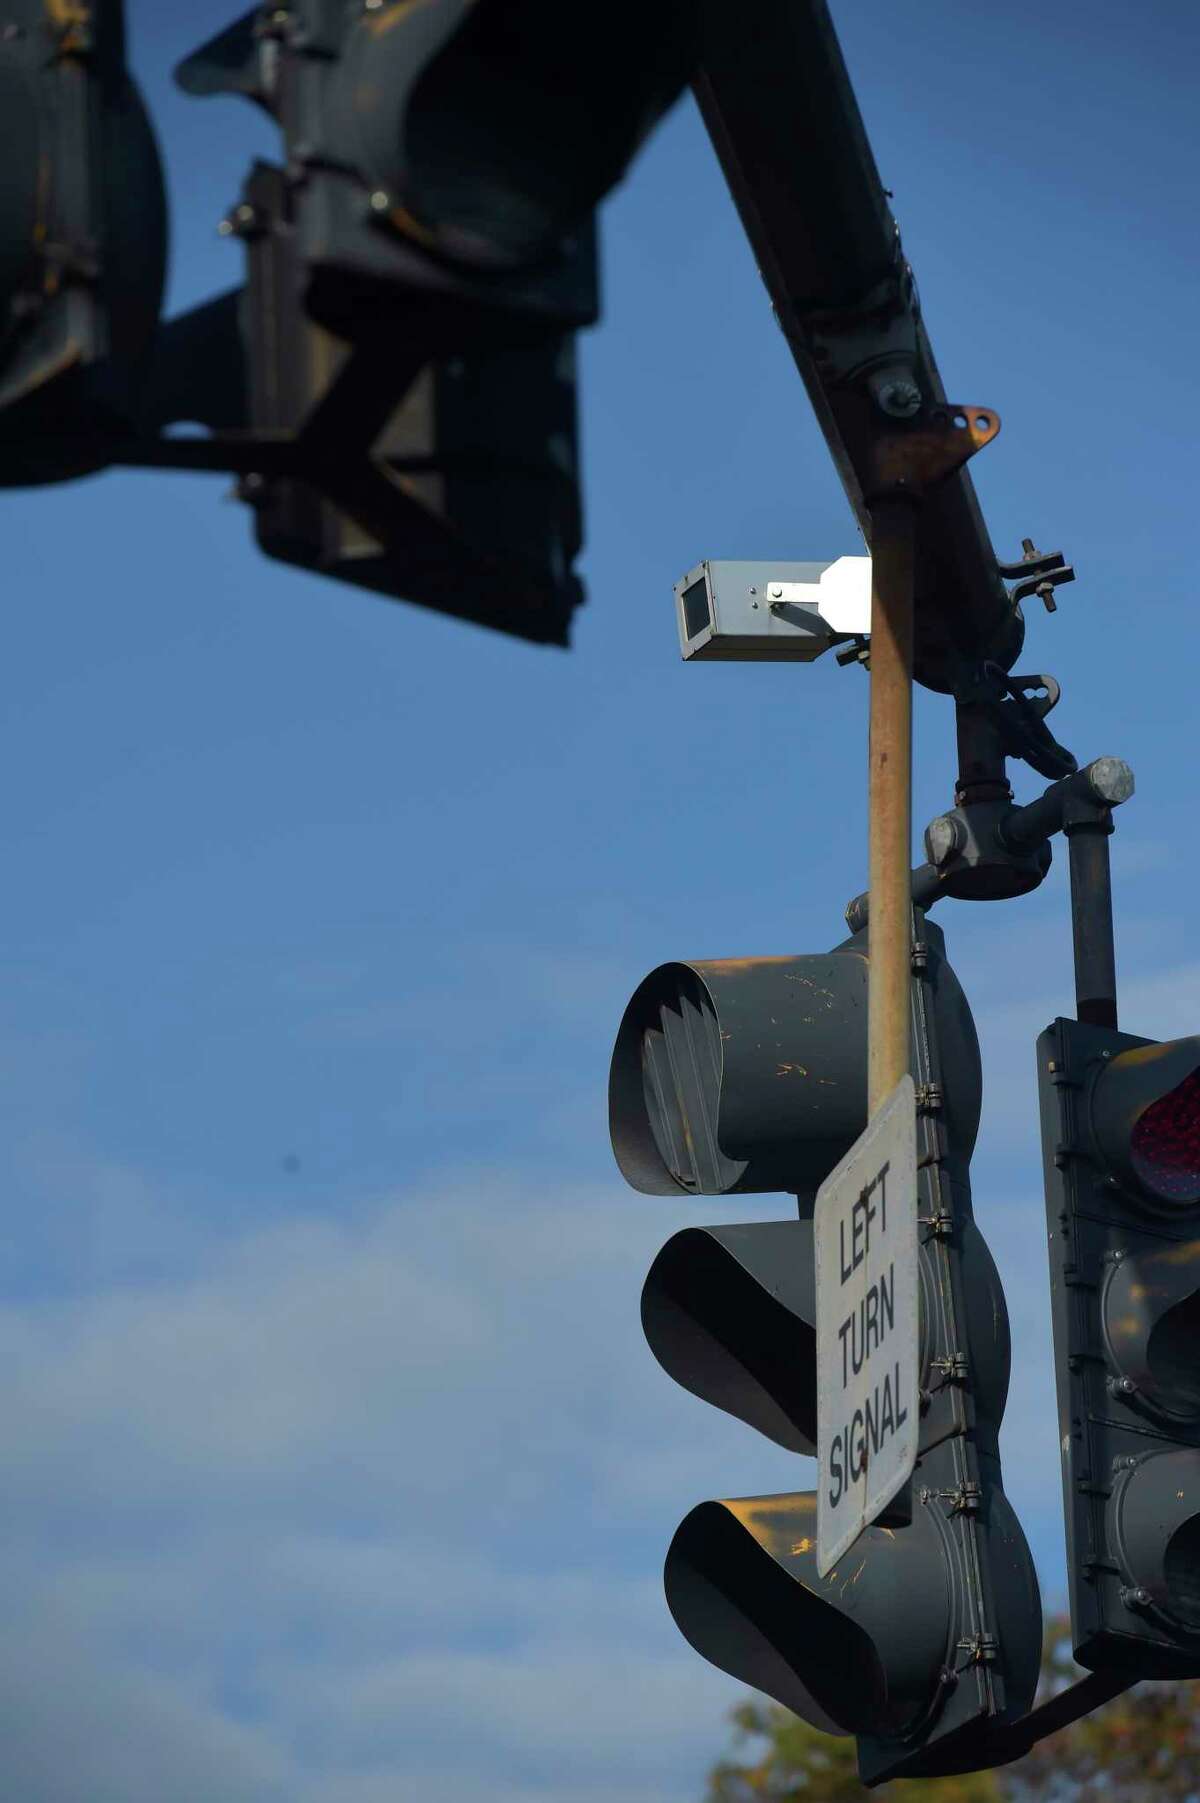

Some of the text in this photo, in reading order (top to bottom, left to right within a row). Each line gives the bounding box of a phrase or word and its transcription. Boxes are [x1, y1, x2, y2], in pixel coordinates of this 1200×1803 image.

[839, 1160, 891, 1286] LEFT
[838, 1263, 896, 1388] TURN
[828, 1362, 908, 1509] SIGNAL
